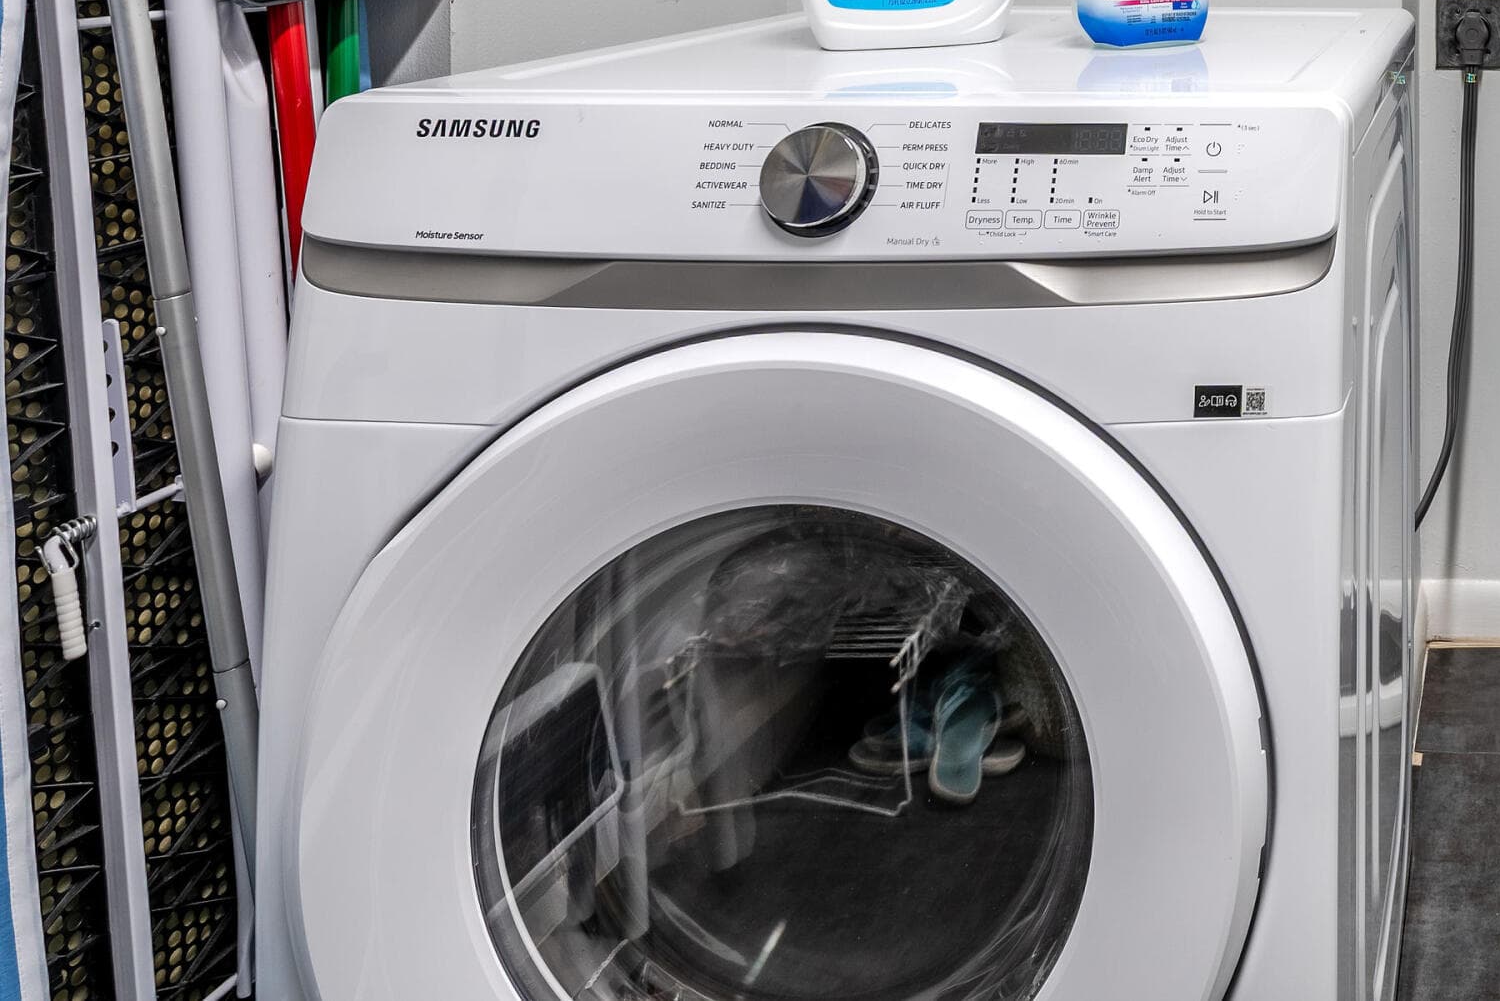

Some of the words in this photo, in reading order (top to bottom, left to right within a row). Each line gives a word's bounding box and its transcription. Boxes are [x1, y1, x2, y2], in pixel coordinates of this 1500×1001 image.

[416, 118, 541, 138] SAMSUNG
[707, 120, 744, 128] NORMAL
[908, 121, 952, 129] DELICATES
[1146, 136, 1159, 145] Dry
[1165, 136, 1188, 145] Adjust
[703, 143, 731, 151] HEAVY
[732, 143, 755, 151] DUTY
[902, 143, 924, 152] PERM
[925, 143, 949, 152] PRESS
[699, 162, 737, 170] BEDDING
[902, 162, 928, 171] QUICK
[929, 162, 946, 170] DRY
[1021, 158, 1035, 166] High
[1132, 167, 1153, 175] Damp
[1162, 167, 1186, 175] Adjust
[1133, 175, 1151, 183] Alert
[695, 181, 748, 190] ACTIVEWEAR
[905, 181, 925, 190] TIME
[926, 181, 943, 190] DRY
[691, 200, 727, 209] SANITIZE
[899, 201, 914, 210] AIR
[915, 201, 941, 210] FLUFF
[1093, 197, 1104, 205] On
[1053, 215, 1073, 224] Time
[1087, 211, 1117, 220] Wrinkle
[968, 215, 1001, 226] Dryness
[1012, 215, 1036, 226] Temp.
[1086, 220, 1116, 228] Prevent
[415, 230, 453, 240] Moisture
[453, 231, 484, 241] Sensor
[886, 237, 914, 246] Manual
[915, 237, 930, 248] Dry
